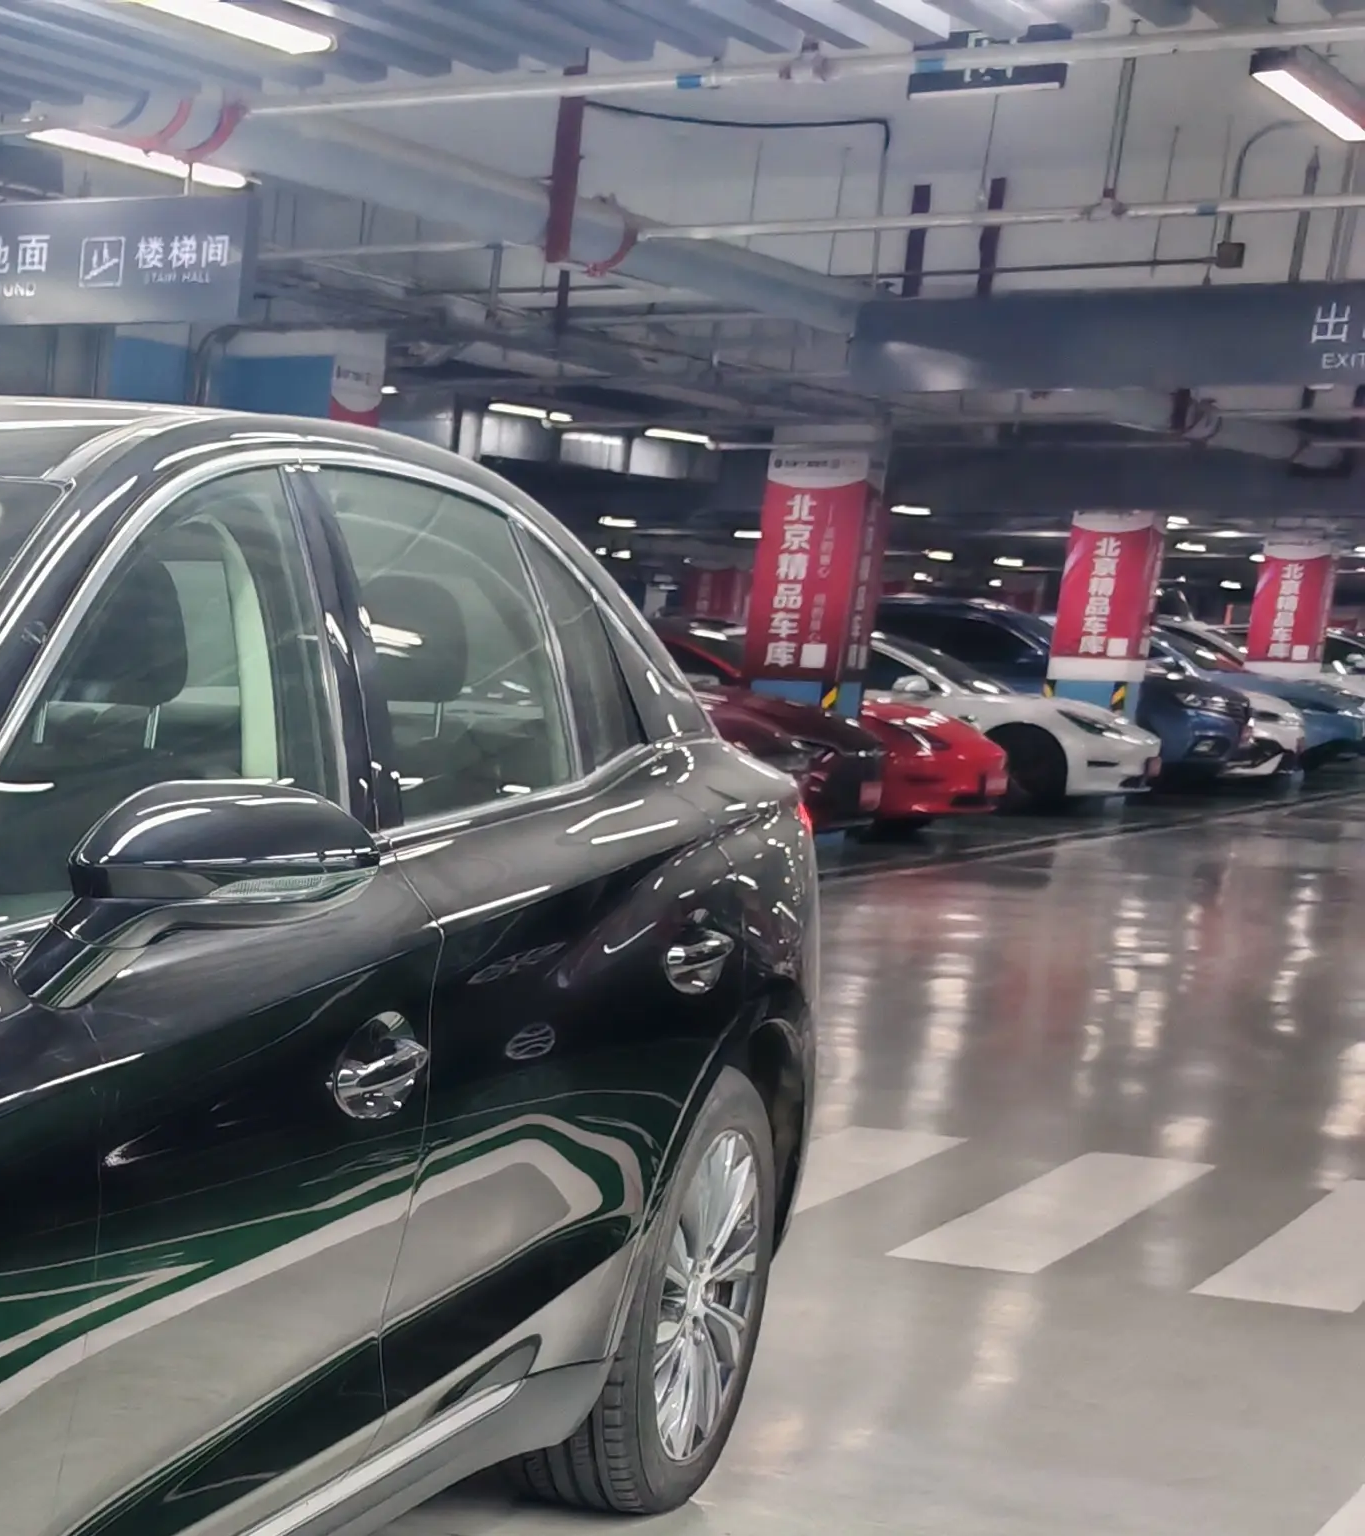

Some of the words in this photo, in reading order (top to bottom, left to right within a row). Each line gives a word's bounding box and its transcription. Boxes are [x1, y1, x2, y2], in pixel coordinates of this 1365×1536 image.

[134, 235, 230, 269] 楼梯间
[143, 273, 177, 286] STAIR
[182, 271, 211, 285] HALL
[1310, 302, 1365, 344] 出
[764, 494, 817, 668] 北京精品车库
[1079, 537, 1121, 654] 北京精品车库
